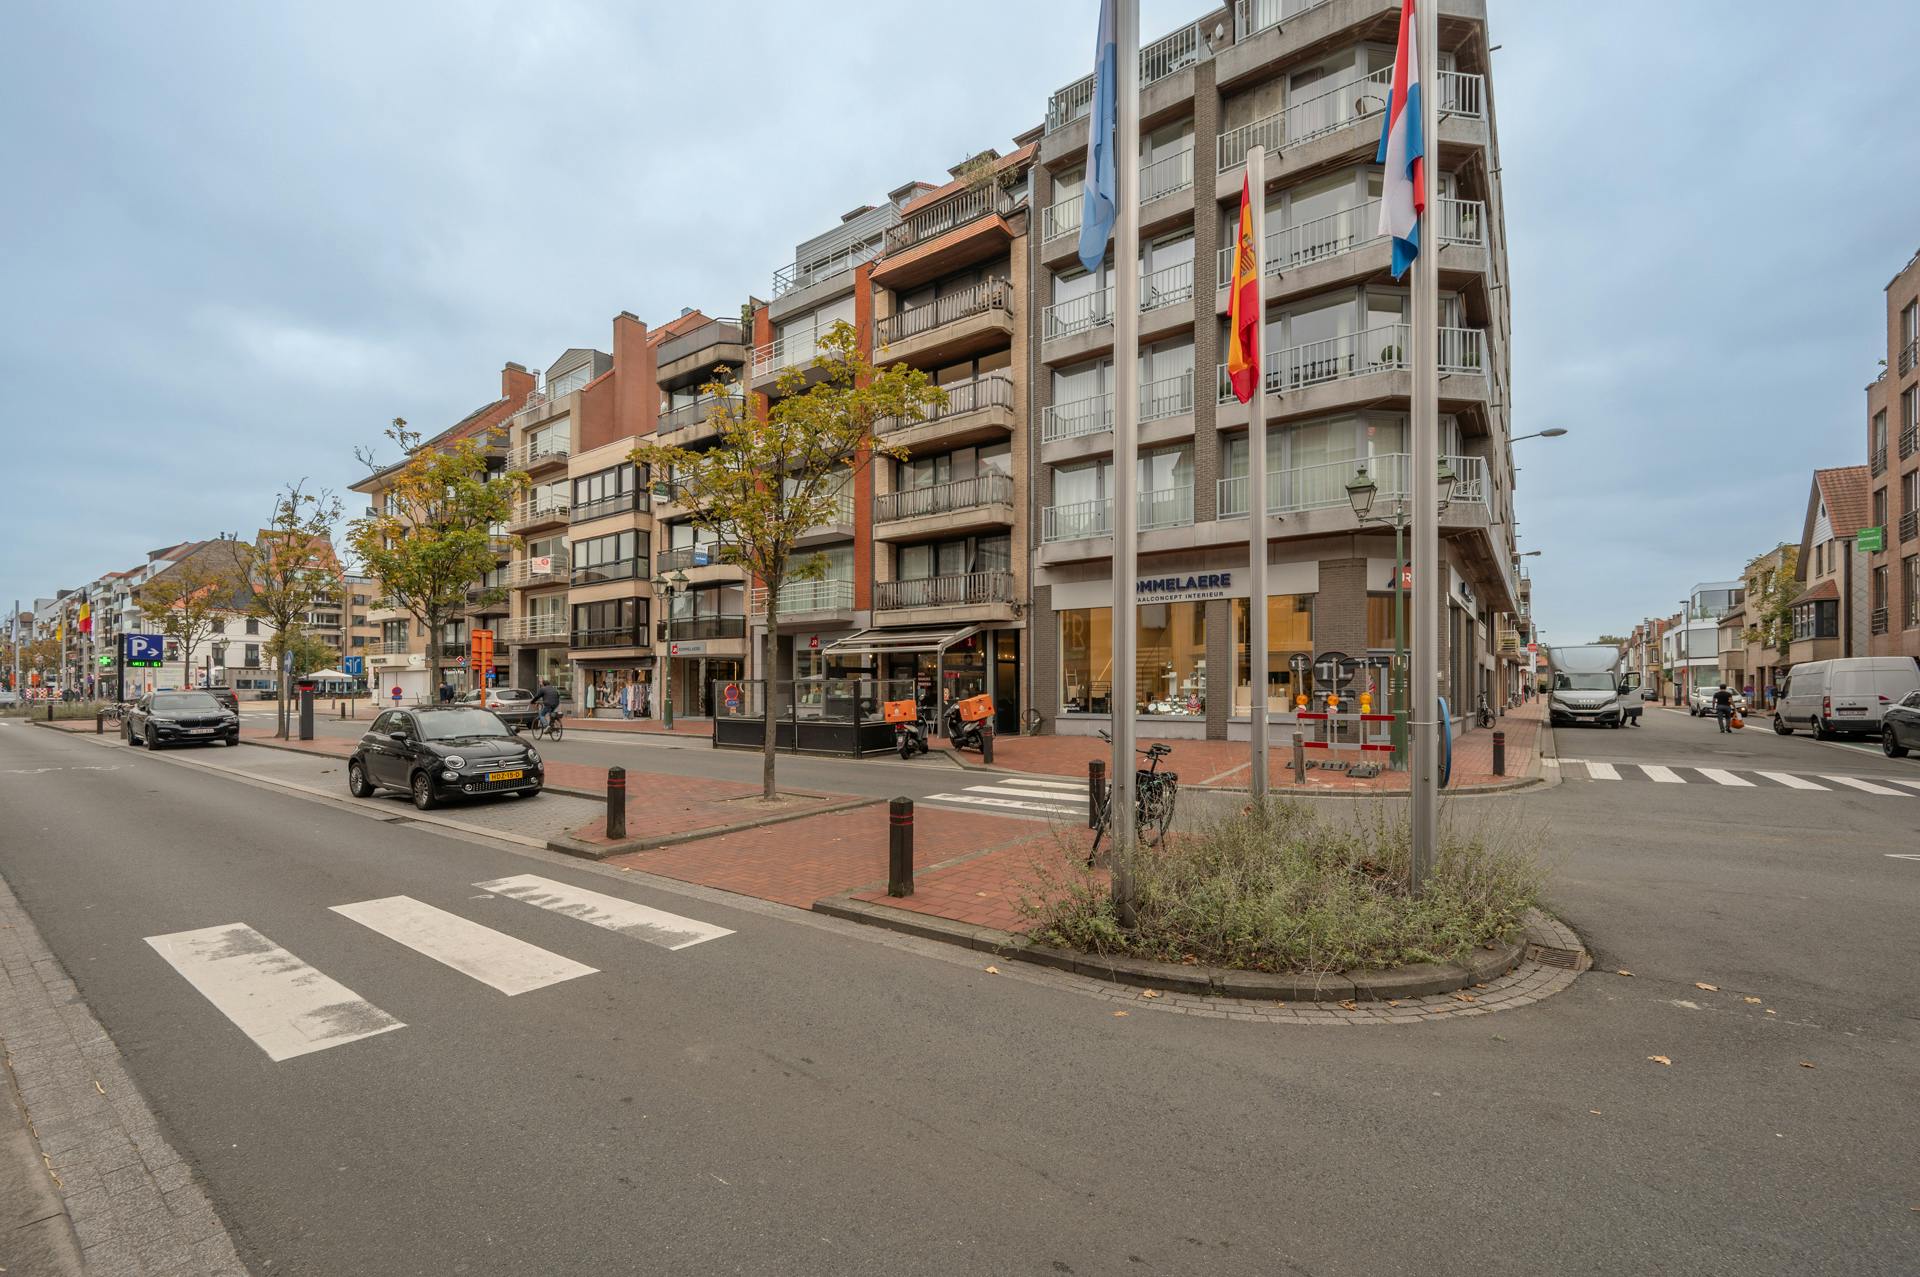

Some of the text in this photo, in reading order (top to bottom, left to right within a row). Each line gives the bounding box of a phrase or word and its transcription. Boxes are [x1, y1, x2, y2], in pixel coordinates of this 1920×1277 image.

[1137, 573, 1231, 593] MMELAERE
[1137, 591, 1224, 603] AALCONCEPT INTERIEUR
[132, 639, 148, 656] P
